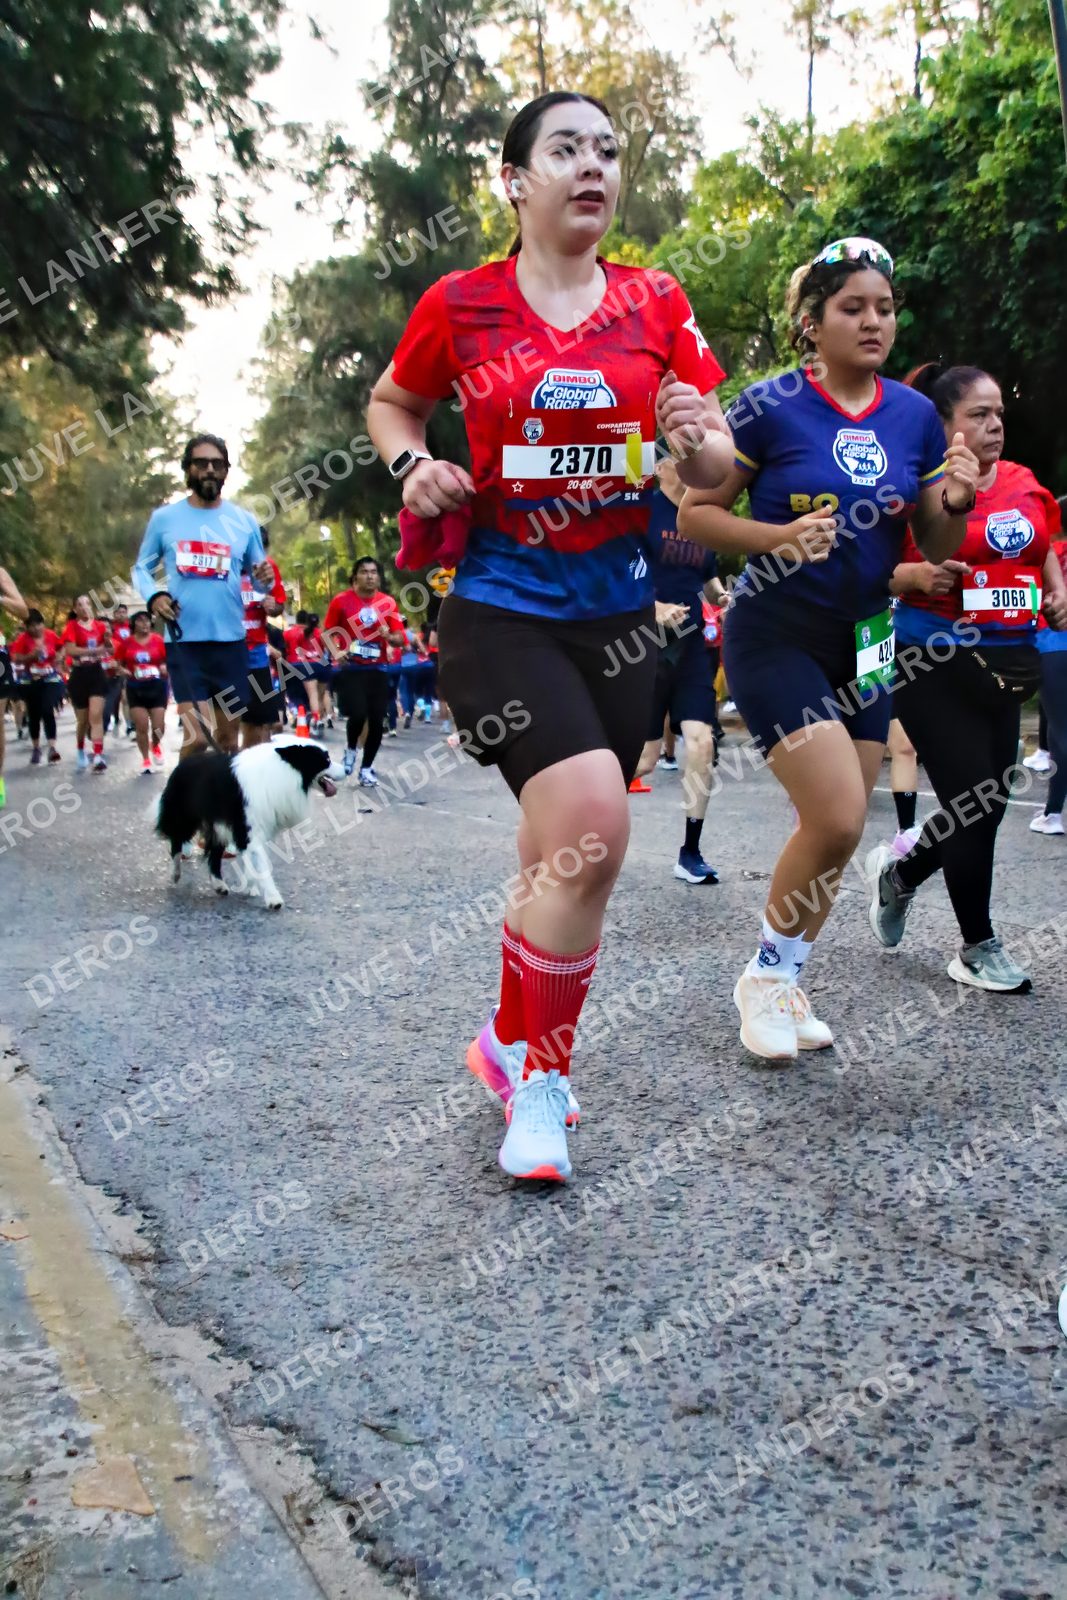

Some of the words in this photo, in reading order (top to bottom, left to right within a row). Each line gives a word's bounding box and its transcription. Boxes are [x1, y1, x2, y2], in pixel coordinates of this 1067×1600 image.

[553, 374, 597, 384] BIMBO
[554, 387, 597, 401] Global
[545, 397, 581, 409] Race
[596, 421, 641, 430] COMPARTIMOS
[843, 434, 871, 443] BIMBO
[842, 448, 867, 459] Race
[847, 443, 877, 454] Global
[549, 446, 612, 476] 2370
[624, 492, 640, 501] 5K
[991, 588, 1026, 608] 3068
